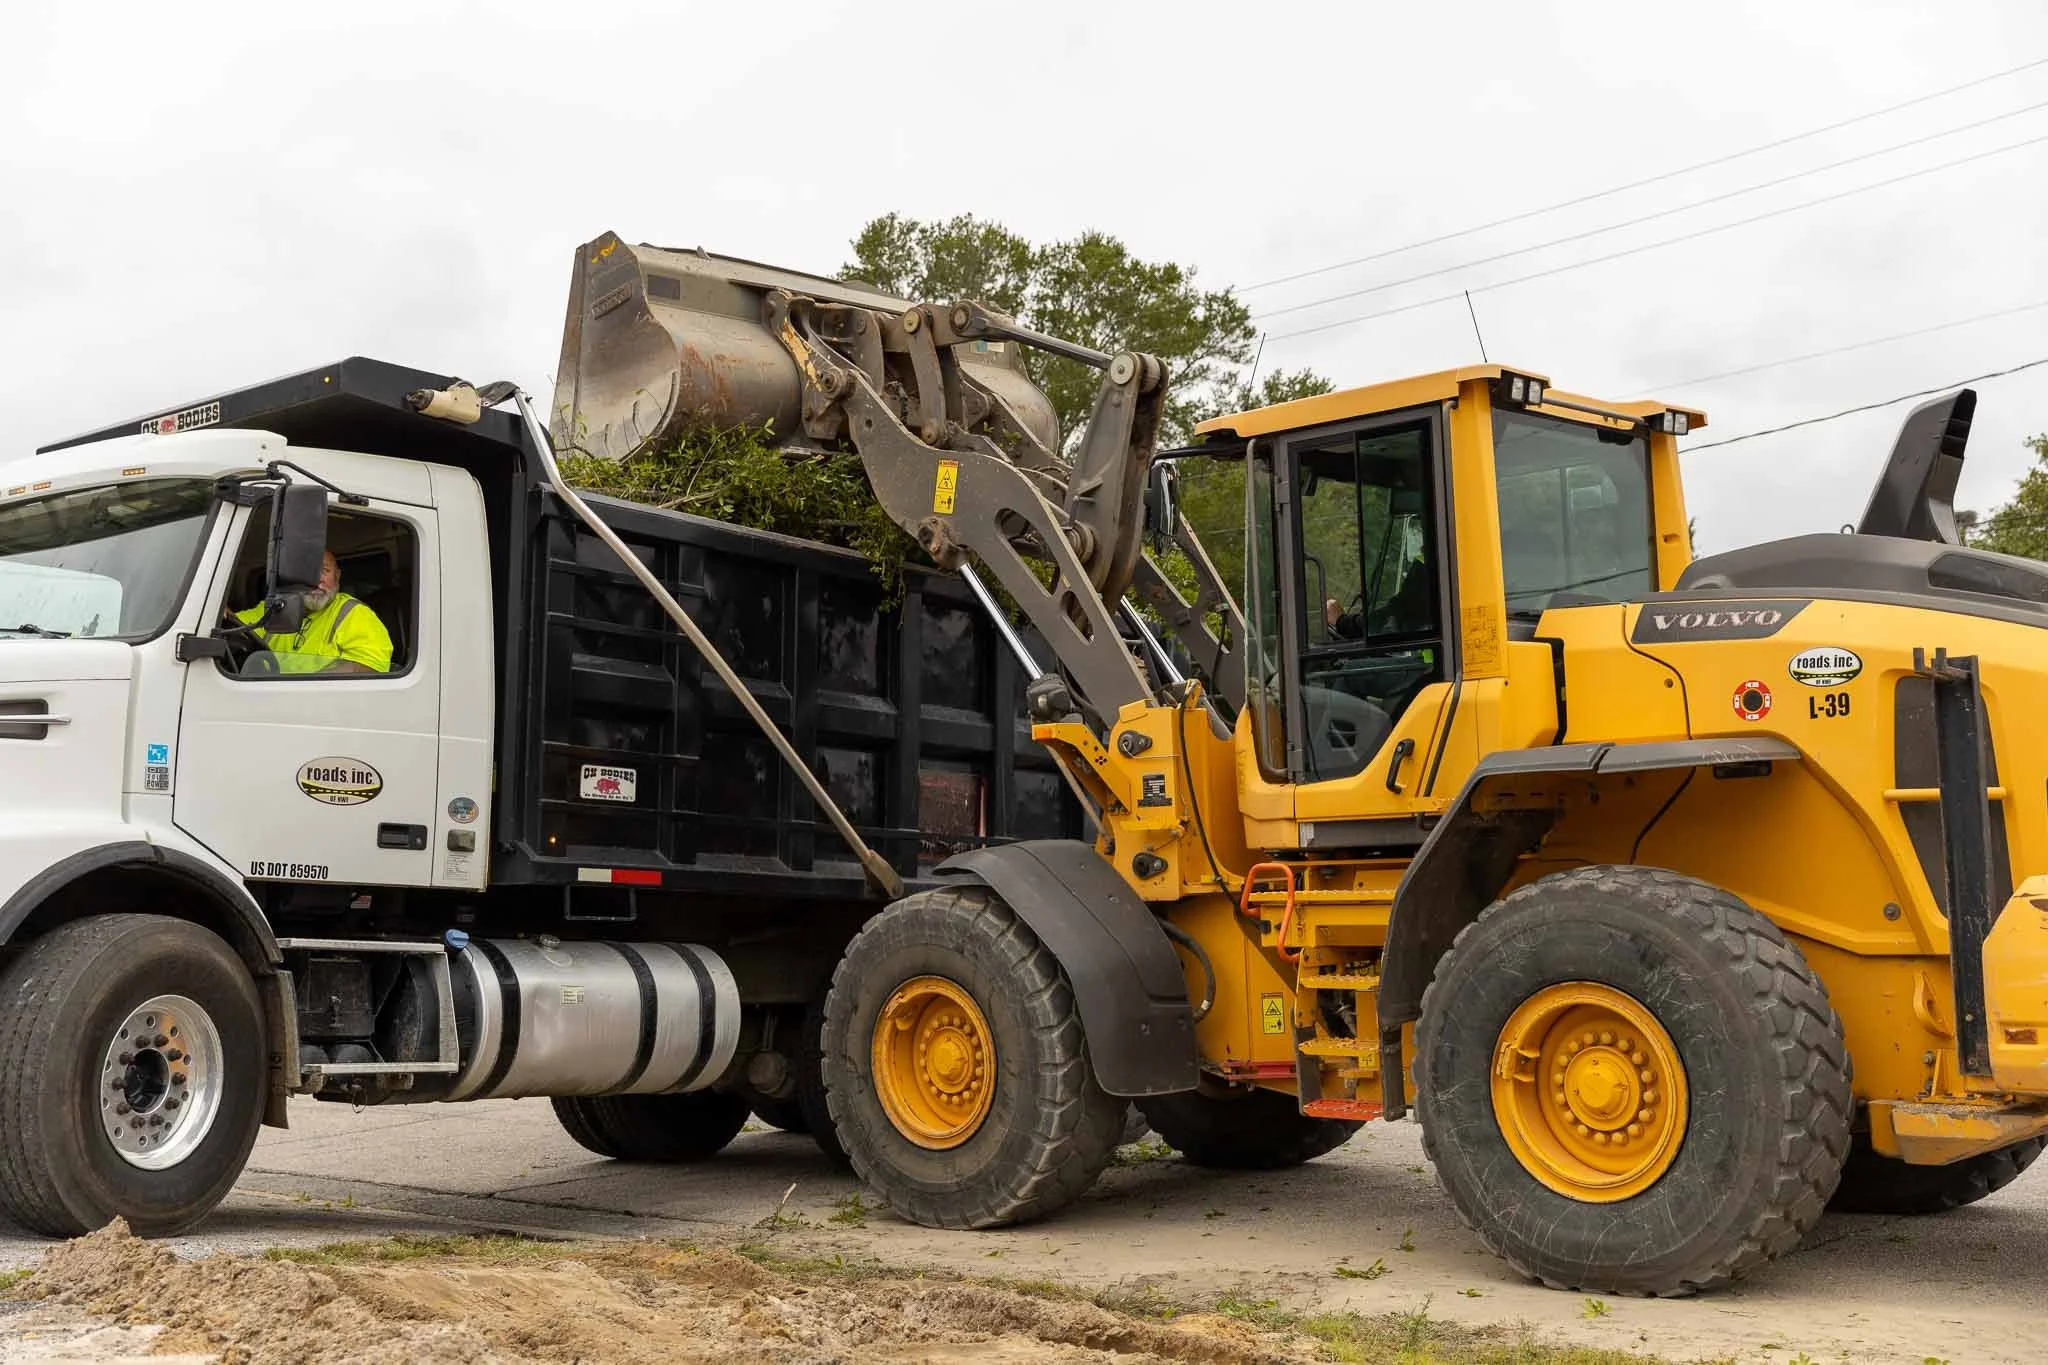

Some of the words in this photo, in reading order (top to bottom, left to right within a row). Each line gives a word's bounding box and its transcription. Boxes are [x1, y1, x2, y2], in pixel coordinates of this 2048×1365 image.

[177, 404, 219, 429] BODIES
[1653, 609, 1782, 630] VOLVO
[1809, 692, 1850, 720] L-39
[600, 768, 635, 784] BODIES
[250, 861, 265, 876] US
[267, 862, 288, 877] DOT
[290, 863, 329, 880] 859570
